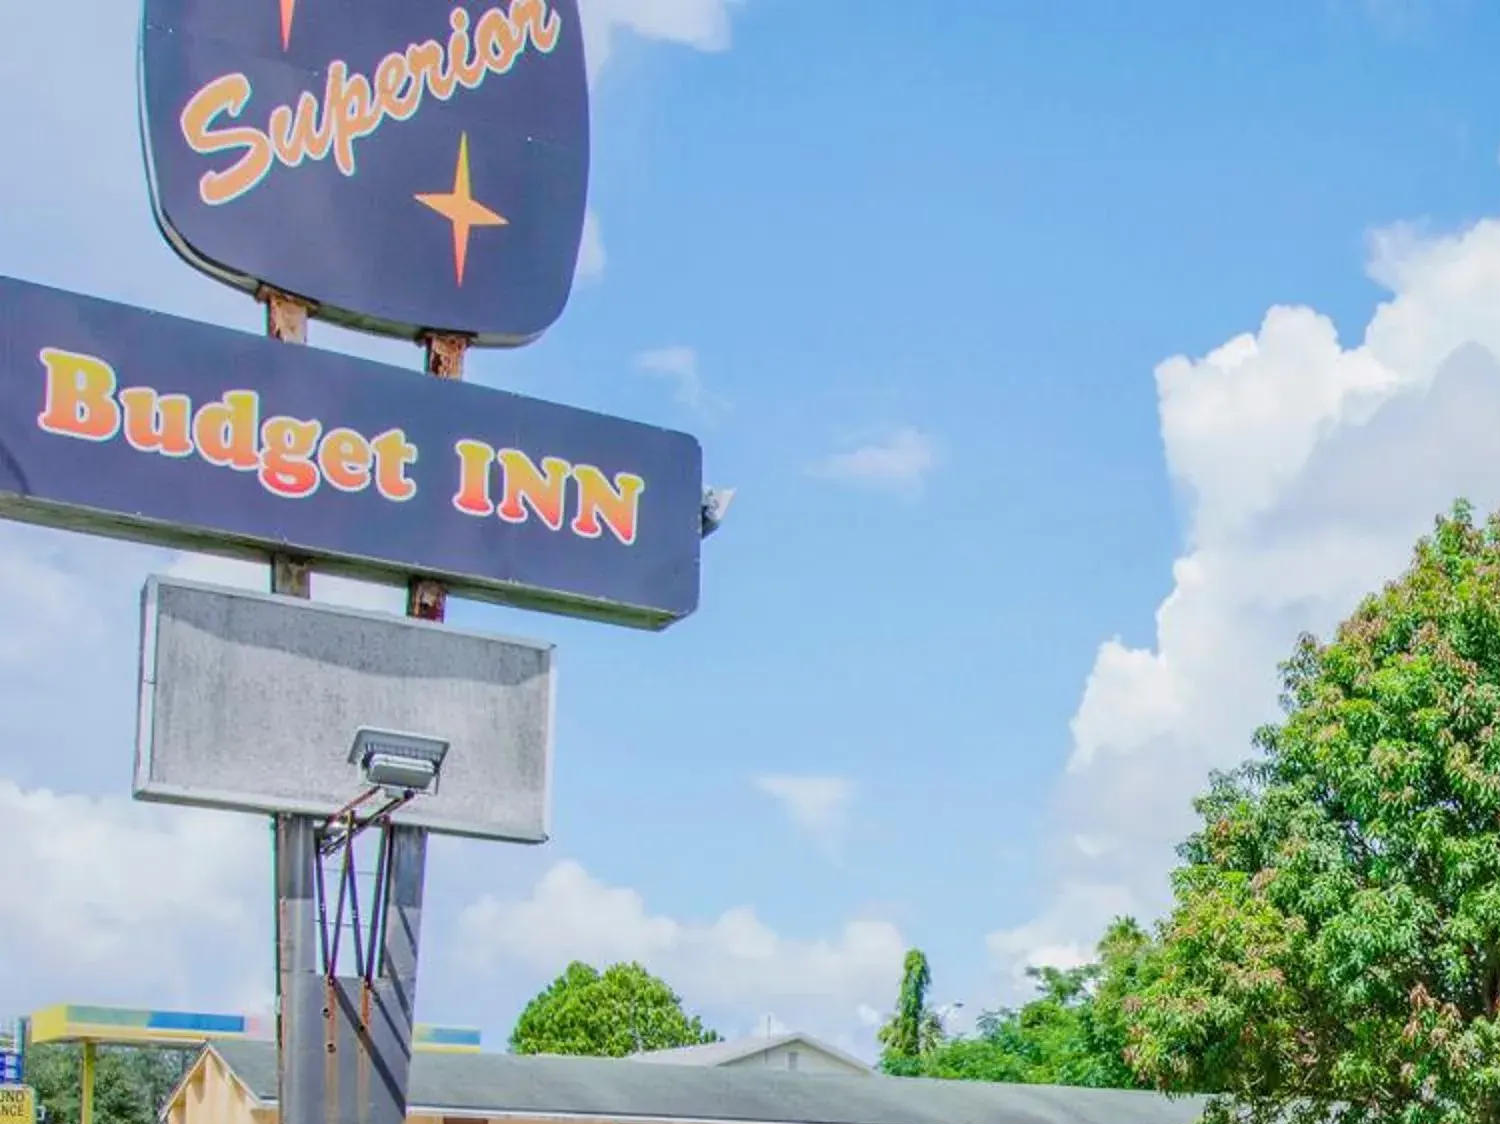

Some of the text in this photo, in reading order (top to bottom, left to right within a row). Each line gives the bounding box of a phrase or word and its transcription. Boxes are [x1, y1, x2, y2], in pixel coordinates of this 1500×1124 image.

[180, 0, 560, 205] Superior
[38, 347, 644, 544] Budget INN
[0, 1104, 24, 1117] NCE
